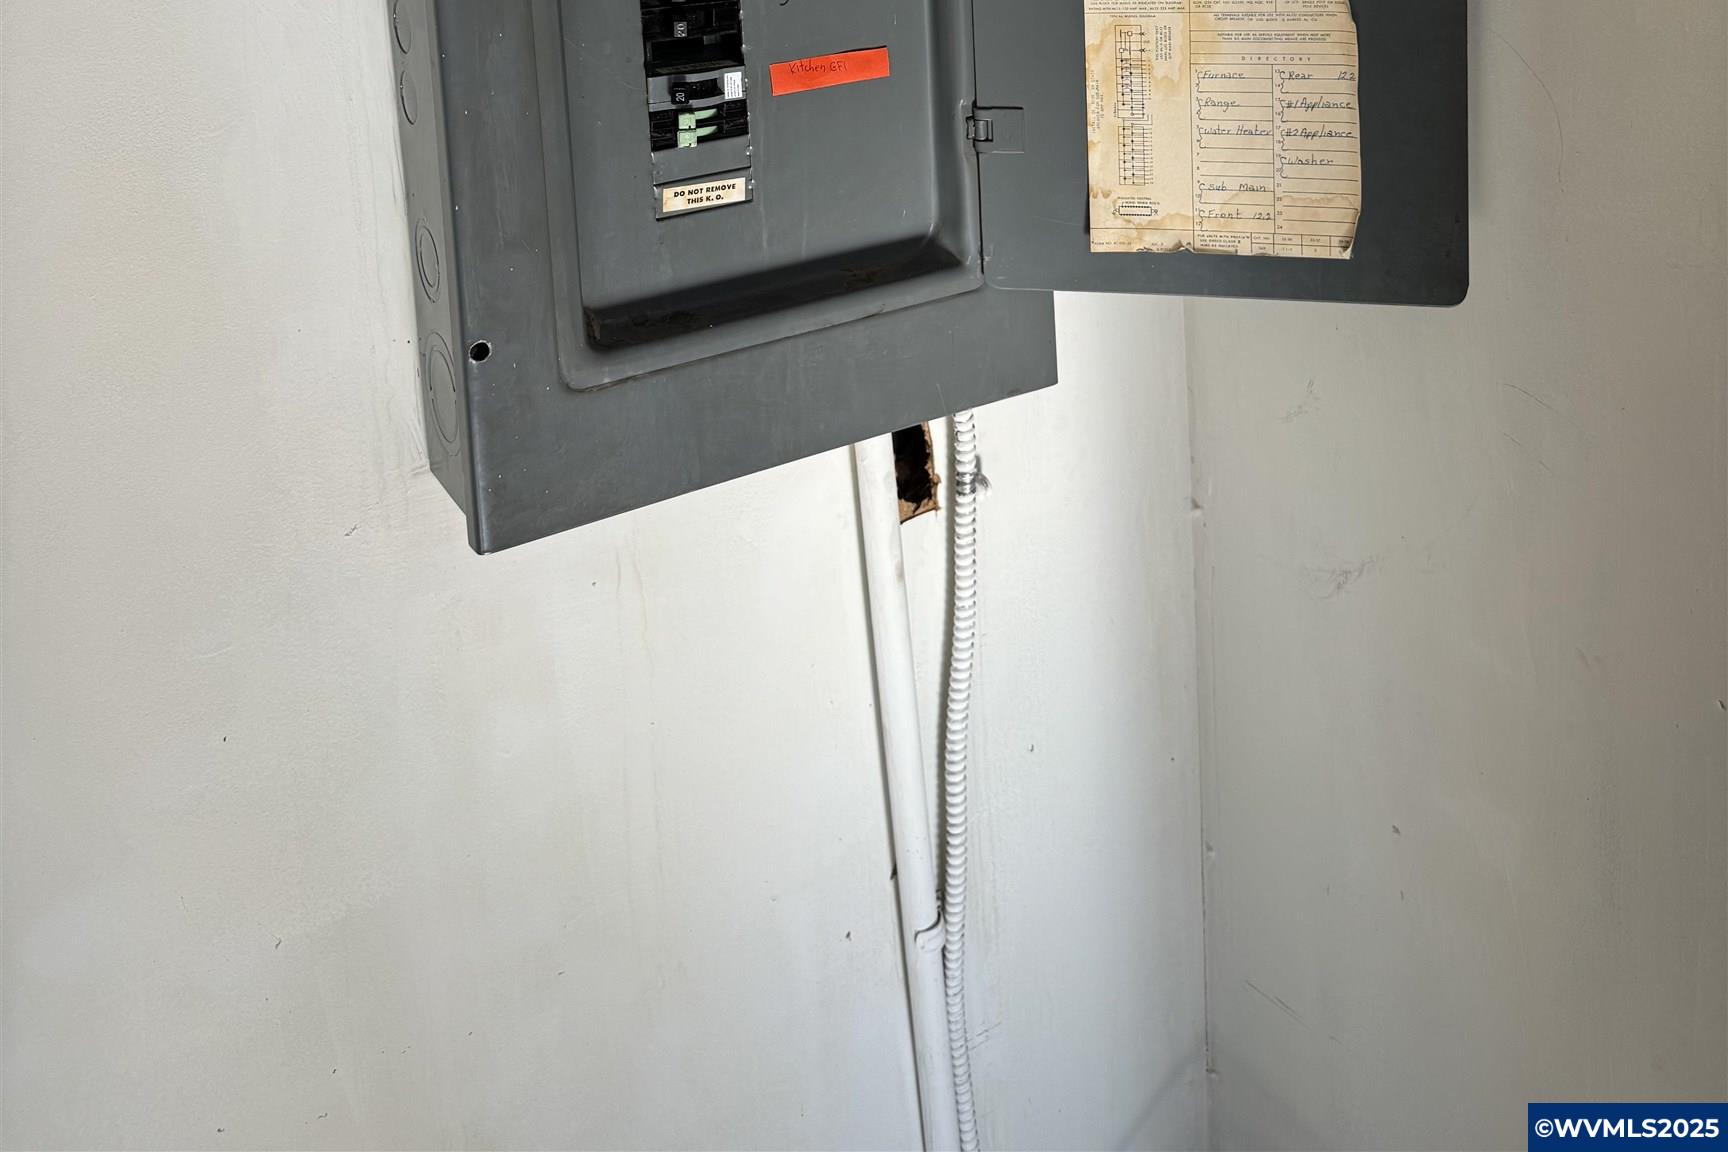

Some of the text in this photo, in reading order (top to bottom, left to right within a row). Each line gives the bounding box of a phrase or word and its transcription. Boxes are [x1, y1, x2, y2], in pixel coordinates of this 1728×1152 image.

[788, 59, 848, 74] Kitchen GFI
[1202, 70, 1246, 79] Furnace
[1288, 70, 1313, 80] Rear
[675, 92, 685, 102] 20
[1204, 96, 1240, 112] Range
[1300, 95, 1352, 112] Appliance
[1235, 123, 1272, 136] Heater
[1300, 123, 1353, 140] Appliance
[673, 183, 736, 198] DO NOT REMOVE
[1239, 182, 1266, 193] Main
[687, 196, 704, 204] THIS
[1208, 208, 1242, 220] Front
